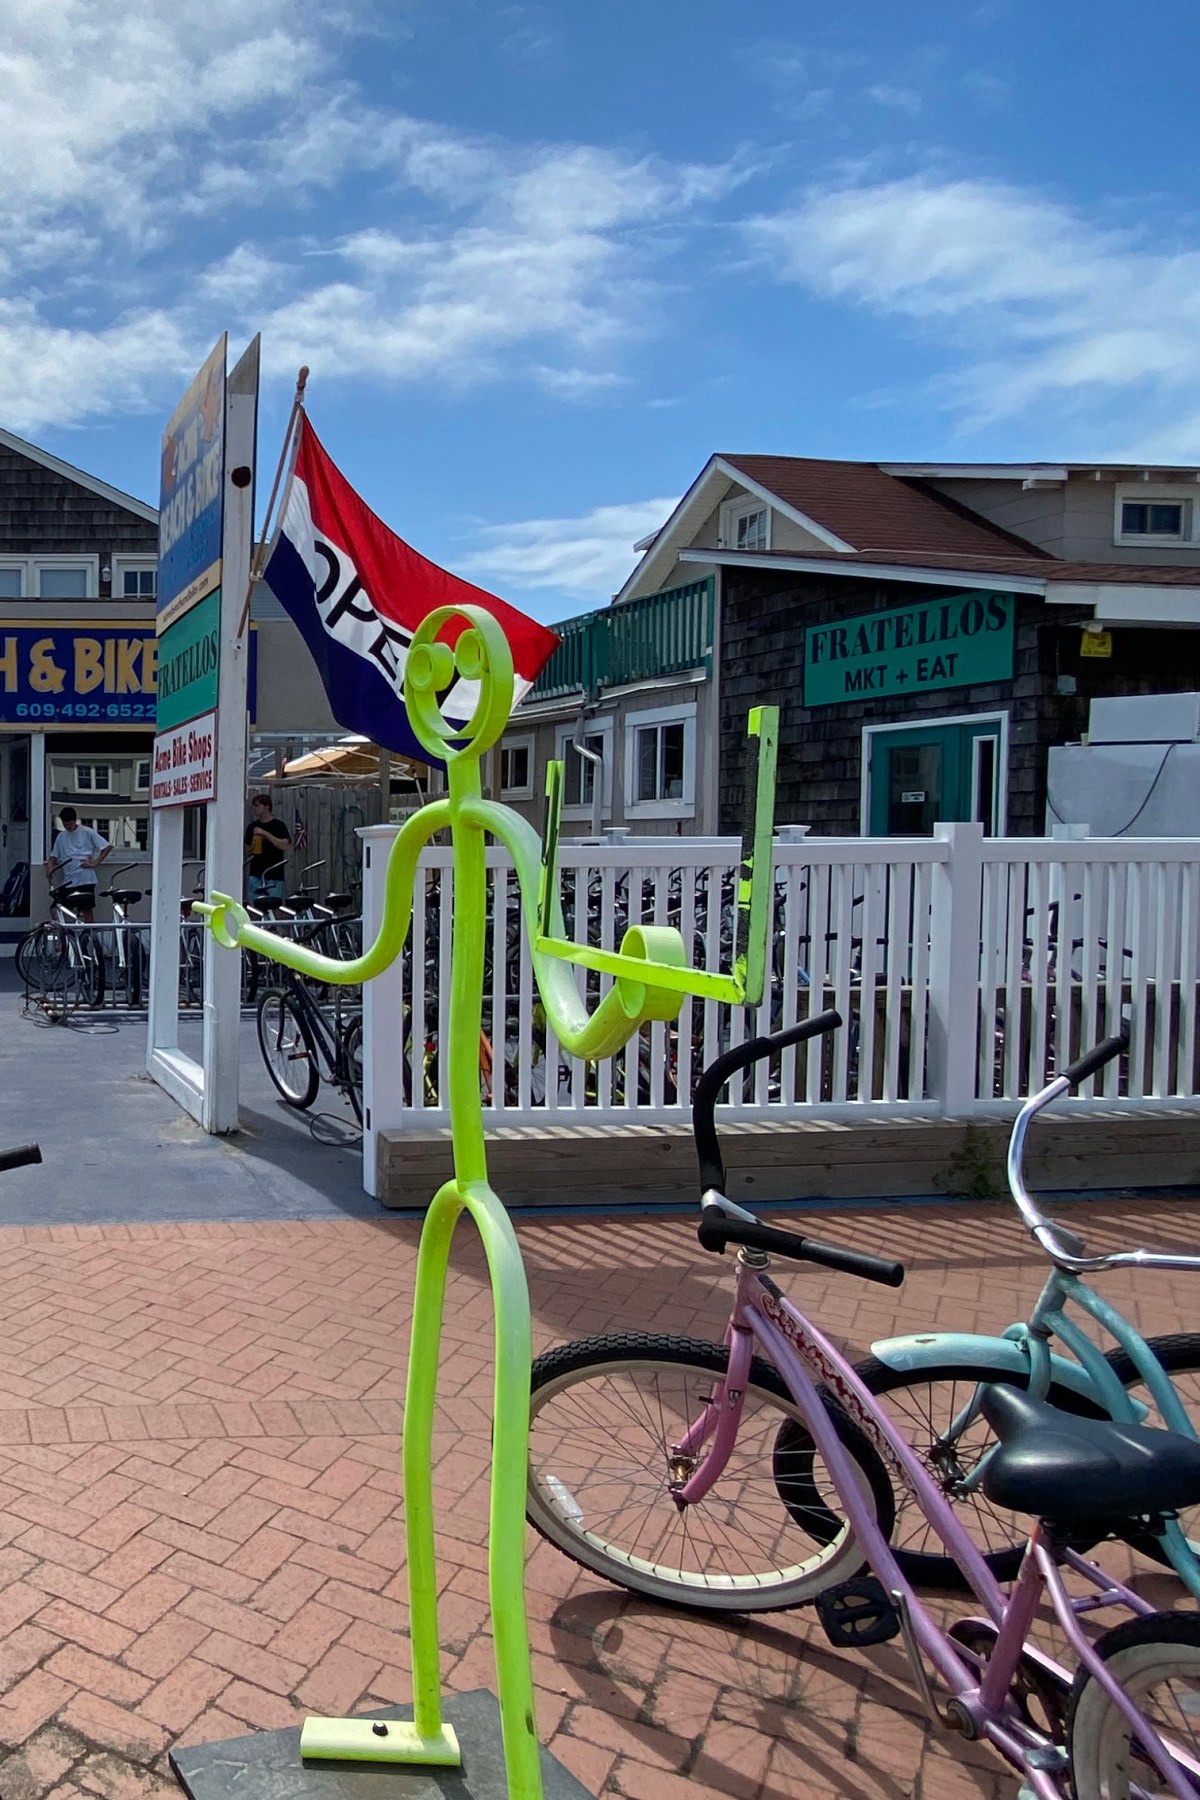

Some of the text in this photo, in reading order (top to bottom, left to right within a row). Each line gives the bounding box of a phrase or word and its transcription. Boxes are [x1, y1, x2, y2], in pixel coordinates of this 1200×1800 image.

[810, 594, 1007, 664] FRATELLOS
[28, 638, 66, 694] &
[74, 638, 158, 694] BIKE
[158, 630, 217, 701] FRATELLOS
[845, 653, 958, 693] MKT + EAT
[155, 731, 212, 773] Acme Bike Shops
[189, 770, 212, 793] SERVICE
